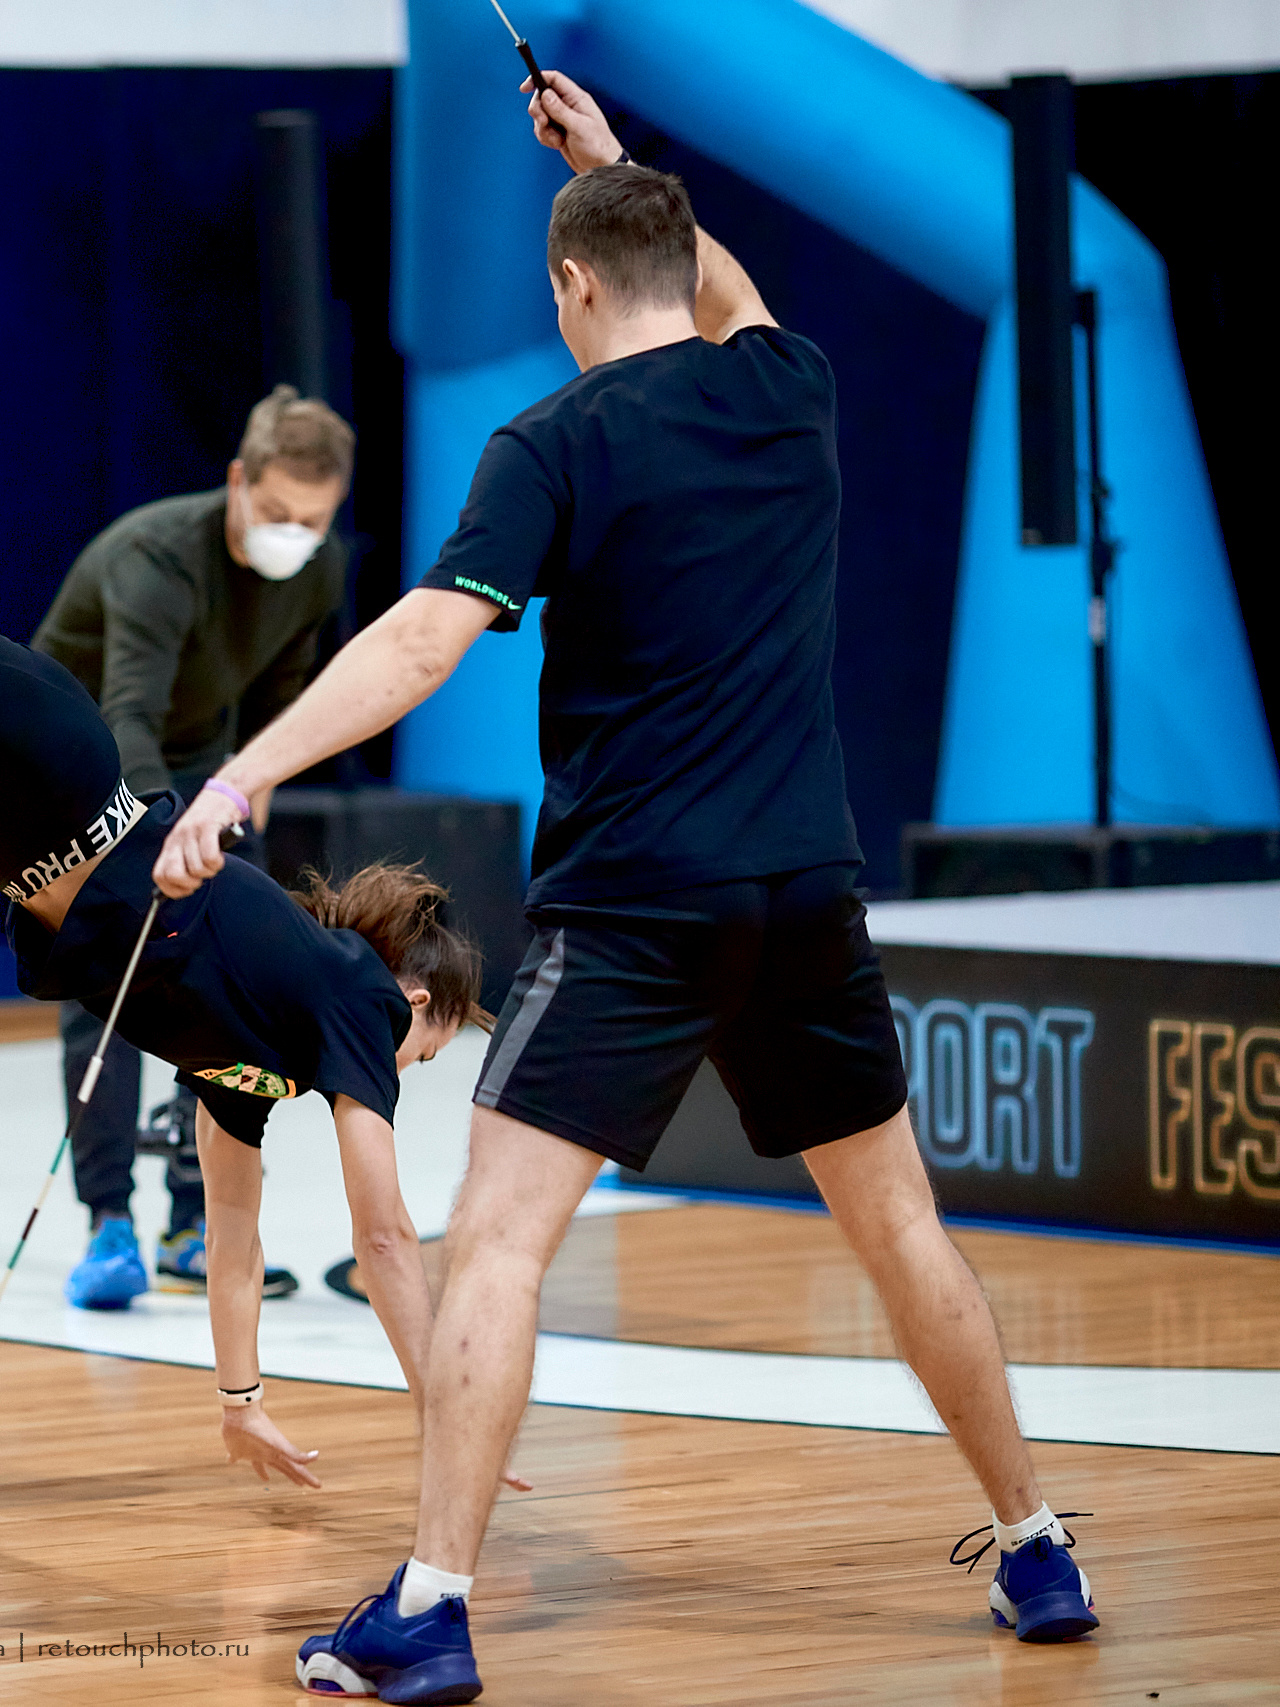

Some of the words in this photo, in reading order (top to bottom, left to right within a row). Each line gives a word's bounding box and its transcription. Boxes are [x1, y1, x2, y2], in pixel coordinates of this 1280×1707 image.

[454, 575, 510, 606] WORLDWIDE
[21, 838, 88, 893] PRO
[1148, 1018, 1280, 1202] FES
